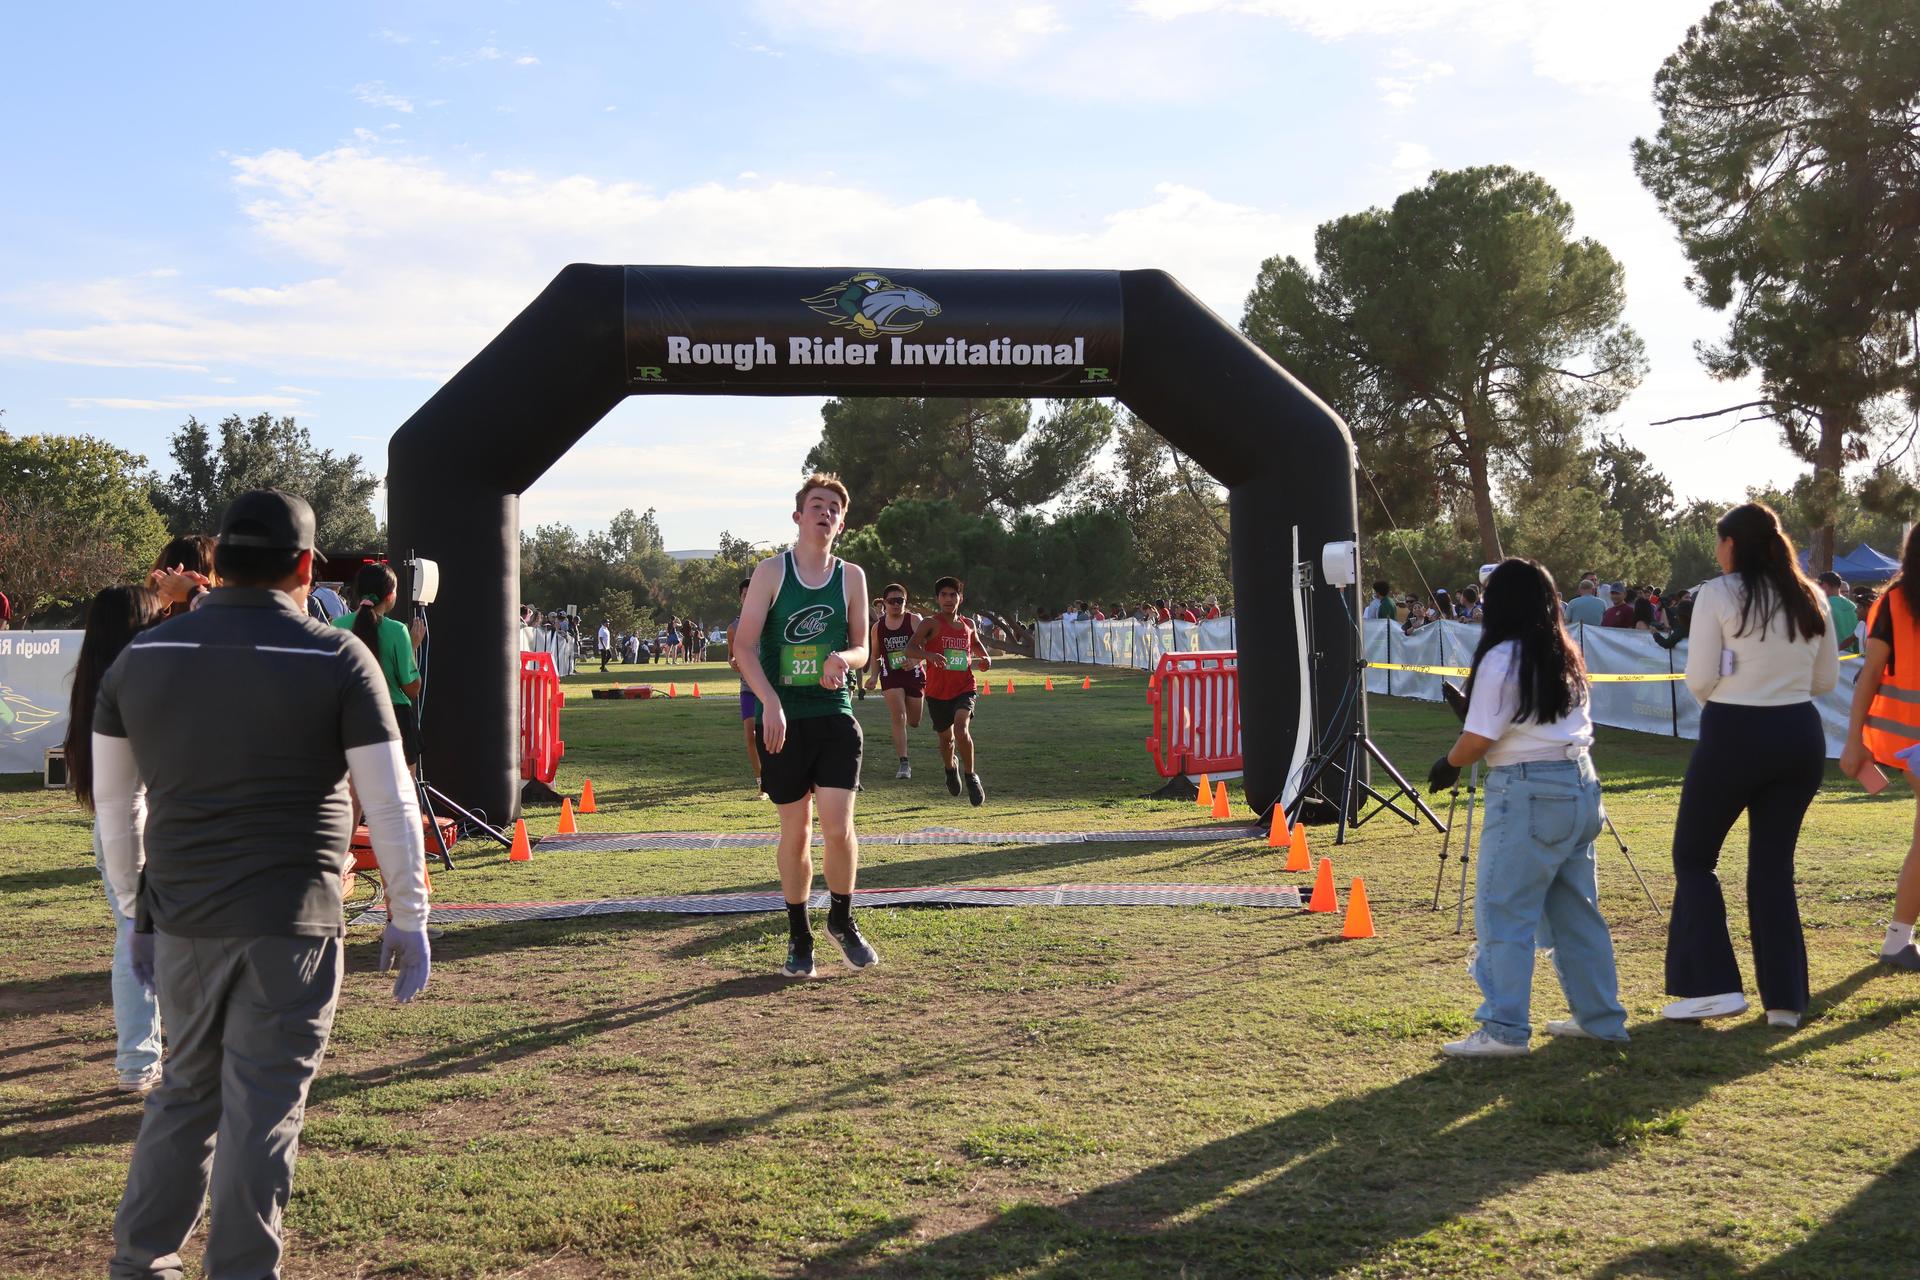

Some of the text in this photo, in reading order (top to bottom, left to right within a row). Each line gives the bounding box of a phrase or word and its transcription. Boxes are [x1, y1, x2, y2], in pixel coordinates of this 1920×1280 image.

[667, 336, 1085, 371] Rough Rider Invitational
[783, 604, 835, 644] Colfax
[941, 635, 969, 650] TRIB
[792, 659, 818, 675] 321
[950, 656, 964, 665] 297
